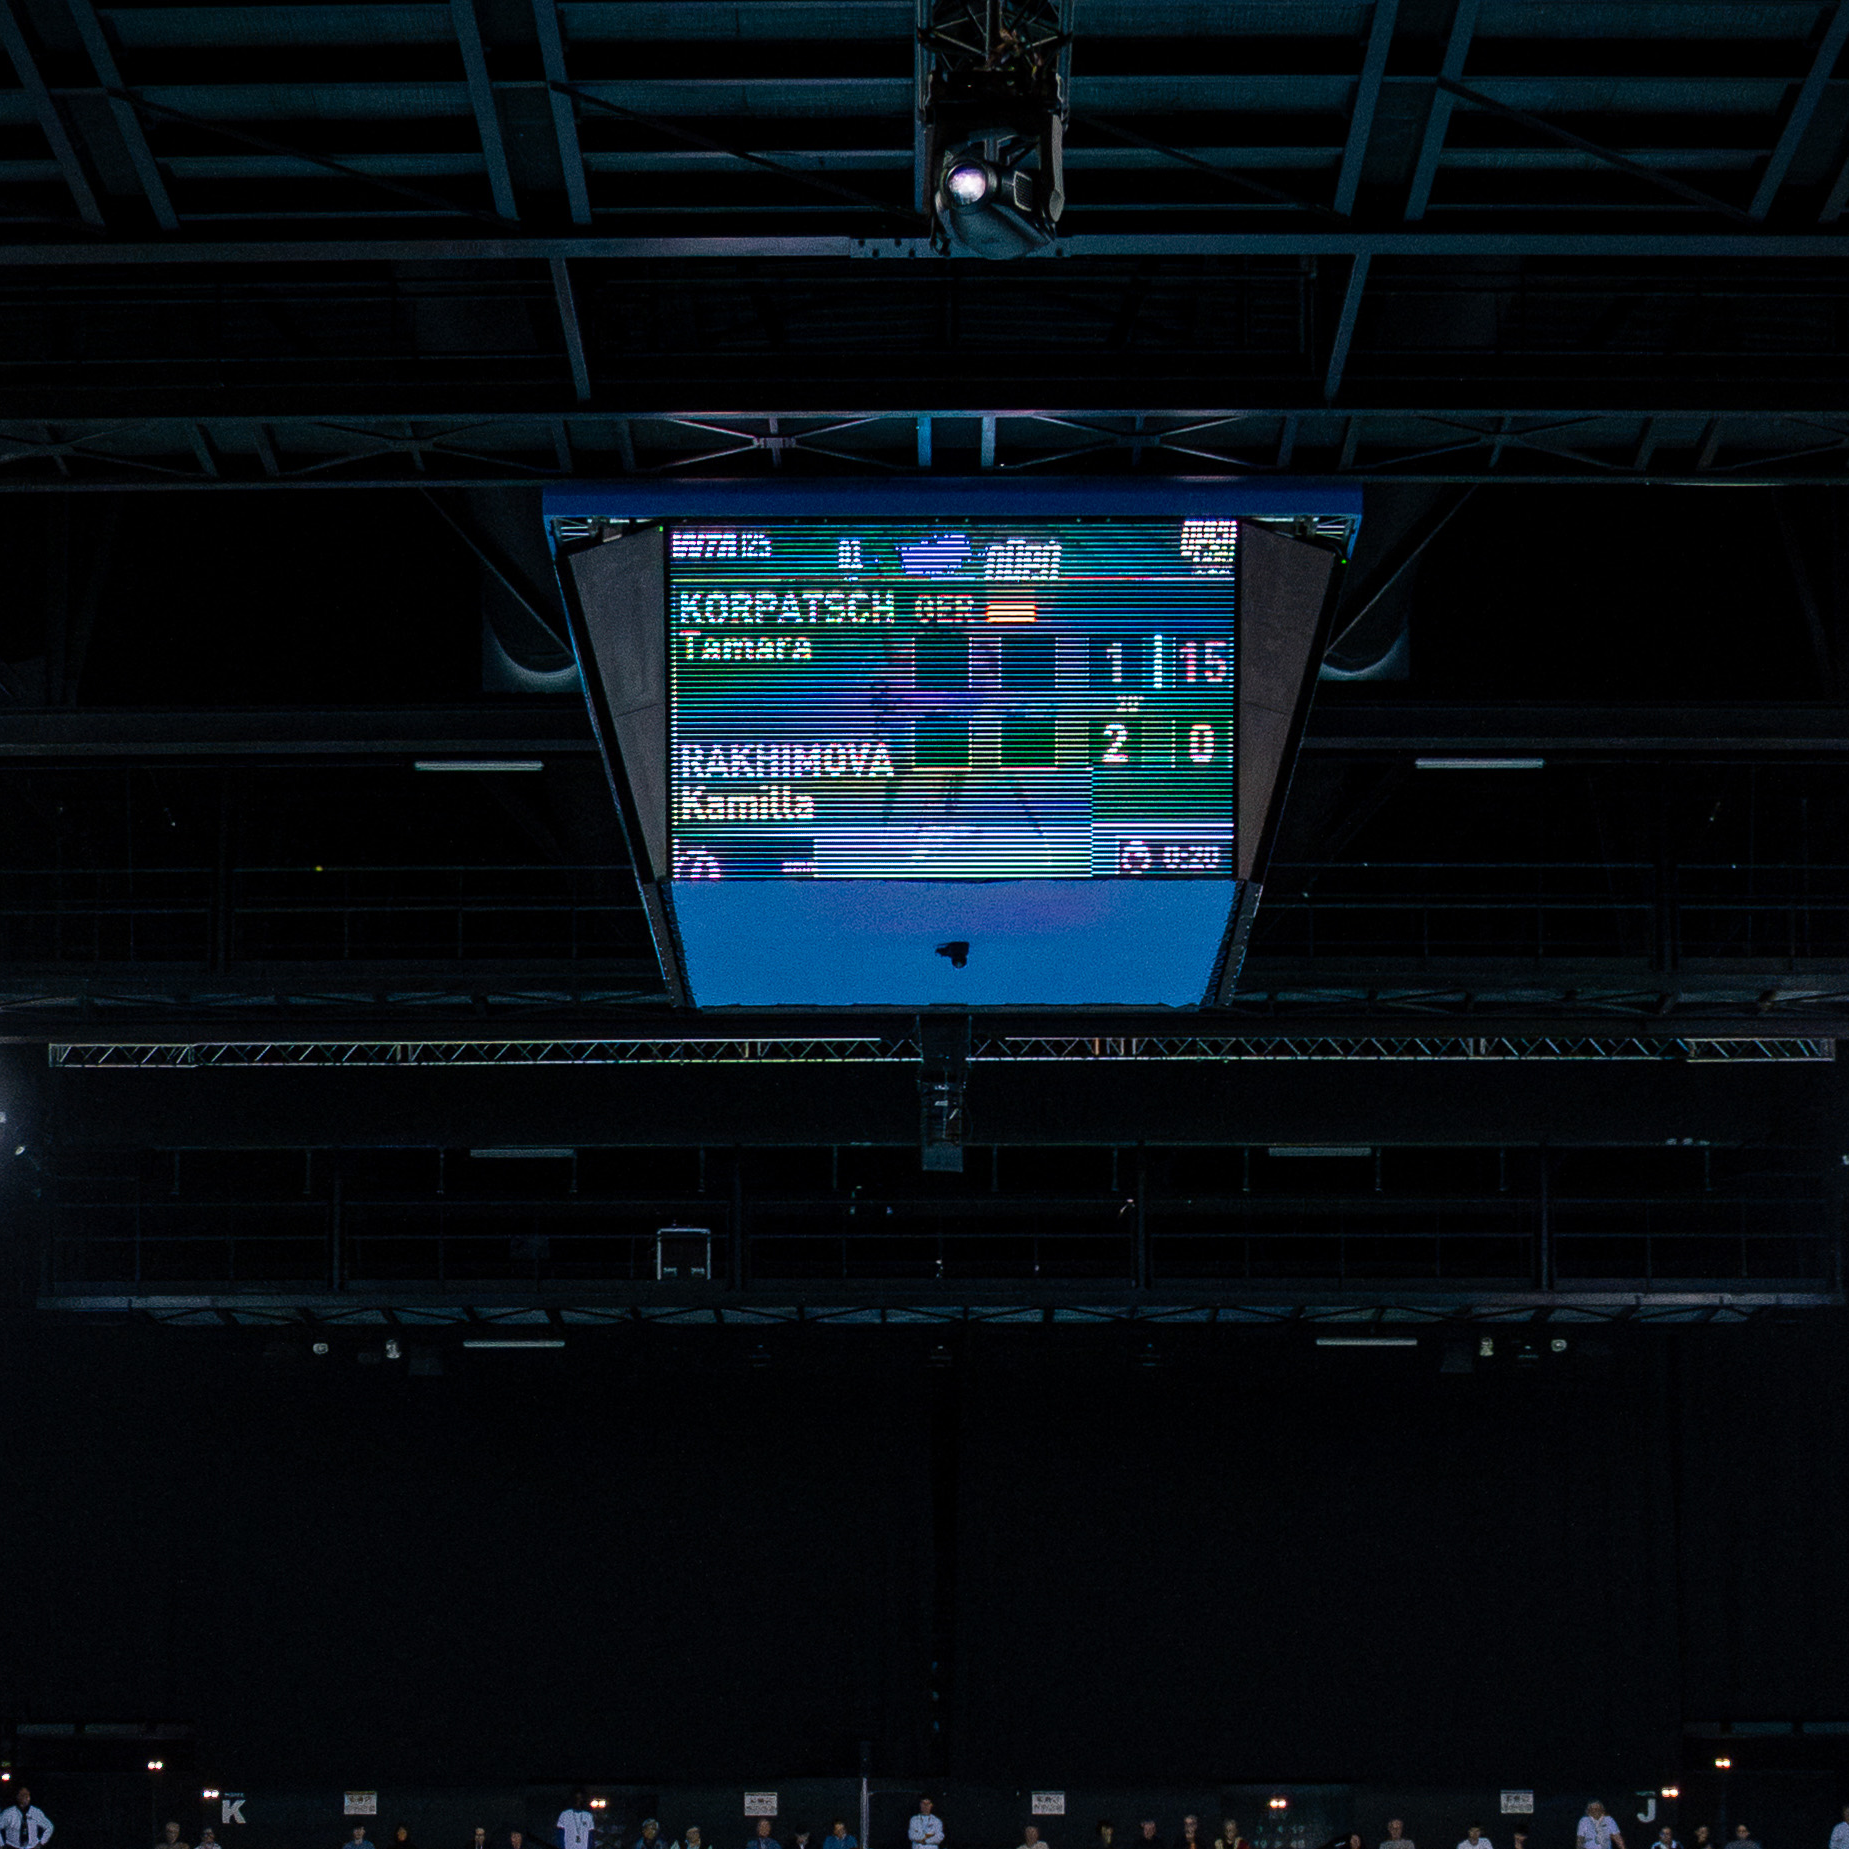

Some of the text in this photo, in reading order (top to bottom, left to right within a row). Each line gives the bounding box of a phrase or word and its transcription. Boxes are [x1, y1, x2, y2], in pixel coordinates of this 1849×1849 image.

[679, 589, 895, 624] KORPATSCH
[680, 630, 812, 661] Tamara
[1106, 641, 1123, 684] 1
[1180, 640, 1228, 684] 15
[680, 742, 895, 778] RAKHIMOVA
[1102, 722, 1129, 764] 2
[1188, 722, 1215, 764] 0
[680, 785, 815, 821] Kamilla
[222, 1799, 247, 1824] K
[1637, 1797, 1657, 1823] J
